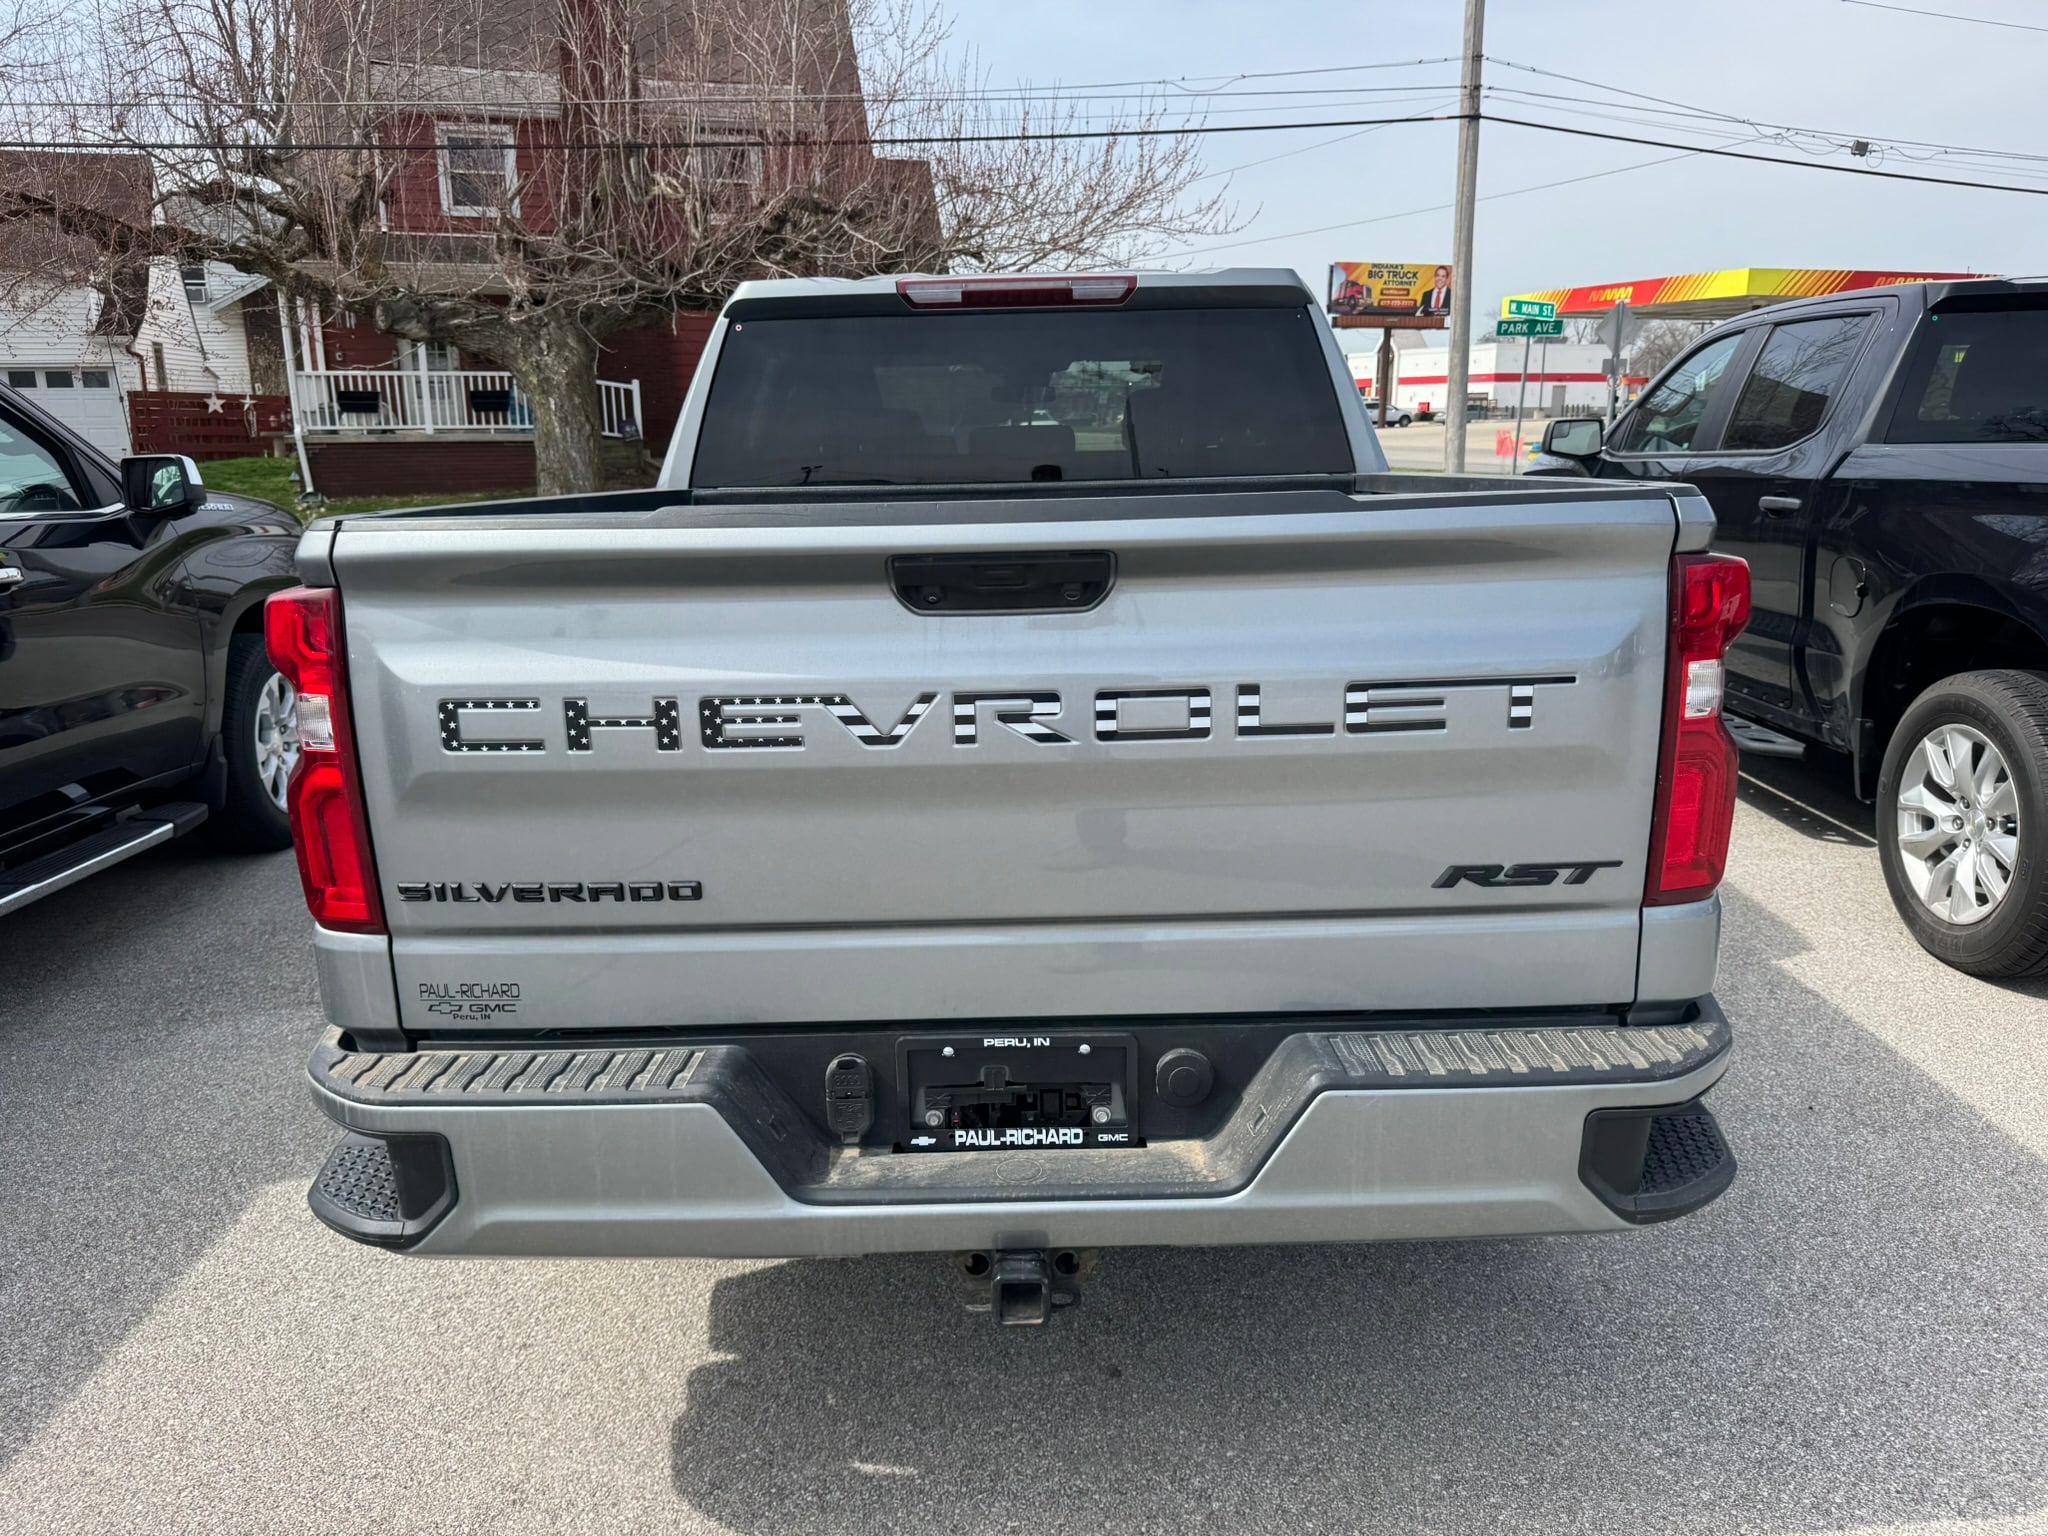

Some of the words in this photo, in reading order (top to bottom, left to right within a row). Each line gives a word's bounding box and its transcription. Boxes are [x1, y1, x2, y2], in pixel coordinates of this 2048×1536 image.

[1367, 270, 1384, 279] BIG
[1386, 270, 1418, 280] TRUCK
[1521, 303, 1539, 315] MAIN
[1501, 323, 1528, 334] PARK
[1535, 322, 1557, 333] AVE.
[440, 675, 1577, 751] CHEVROLET
[1431, 860, 1623, 888] RST
[398, 880, 702, 902] SILVERADO
[419, 983, 520, 998] PAUL-RICHARD
[469, 1003, 517, 1012] GMC
[453, 1013, 478, 1021] Peru,
[983, 1038, 1031, 1048] PERU,
[1034, 1037, 1050, 1046] IN
[955, 1128, 1084, 1146] PAUL-RICHARD
[1098, 1133, 1129, 1141] GMC
